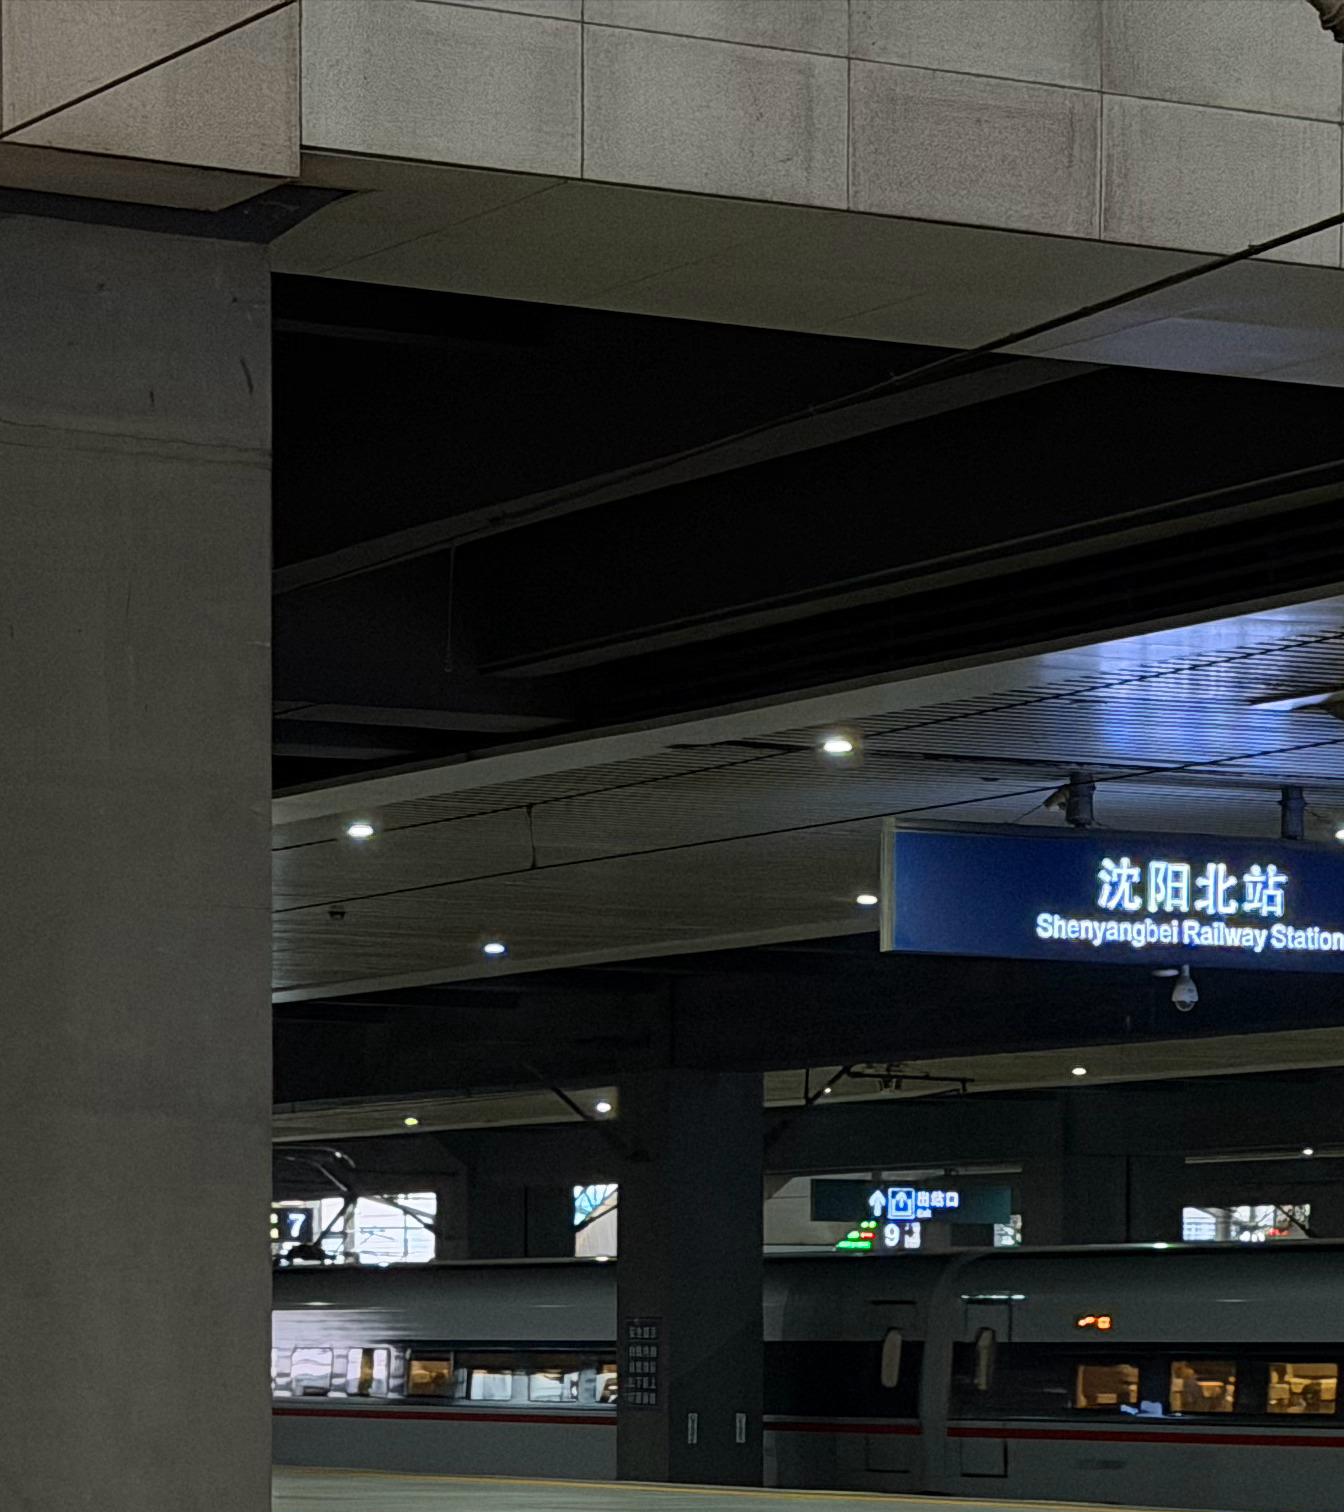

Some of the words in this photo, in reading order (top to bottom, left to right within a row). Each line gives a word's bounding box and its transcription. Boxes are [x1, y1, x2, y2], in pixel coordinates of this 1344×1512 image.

[1096, 857, 1289, 918] 沈阳北站
[1036, 912, 1179, 947] Shenyangbei
[1182, 919, 1268, 953] Railway
